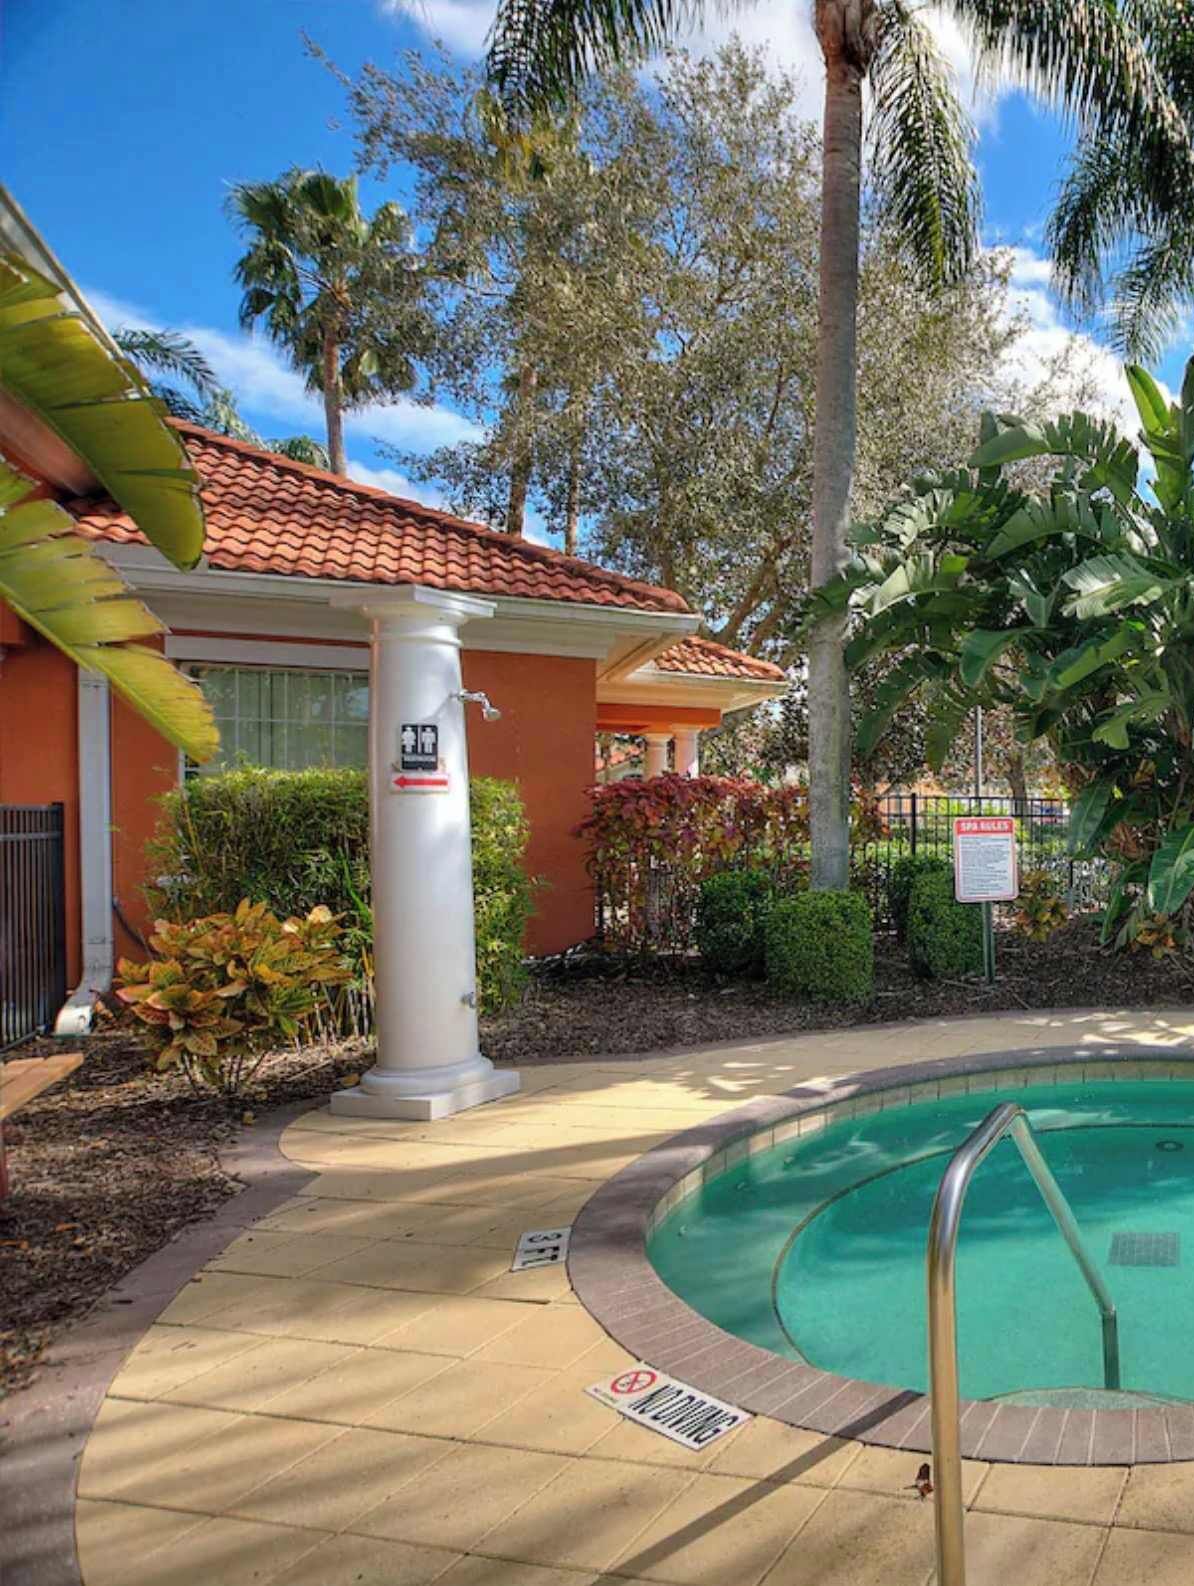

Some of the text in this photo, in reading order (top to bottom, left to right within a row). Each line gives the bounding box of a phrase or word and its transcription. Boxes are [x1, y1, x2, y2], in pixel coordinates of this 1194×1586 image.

[521, 1232, 562, 1266] 3 FT
[628, 1384, 683, 1414] NO
[651, 1395, 739, 1444] DIVING
